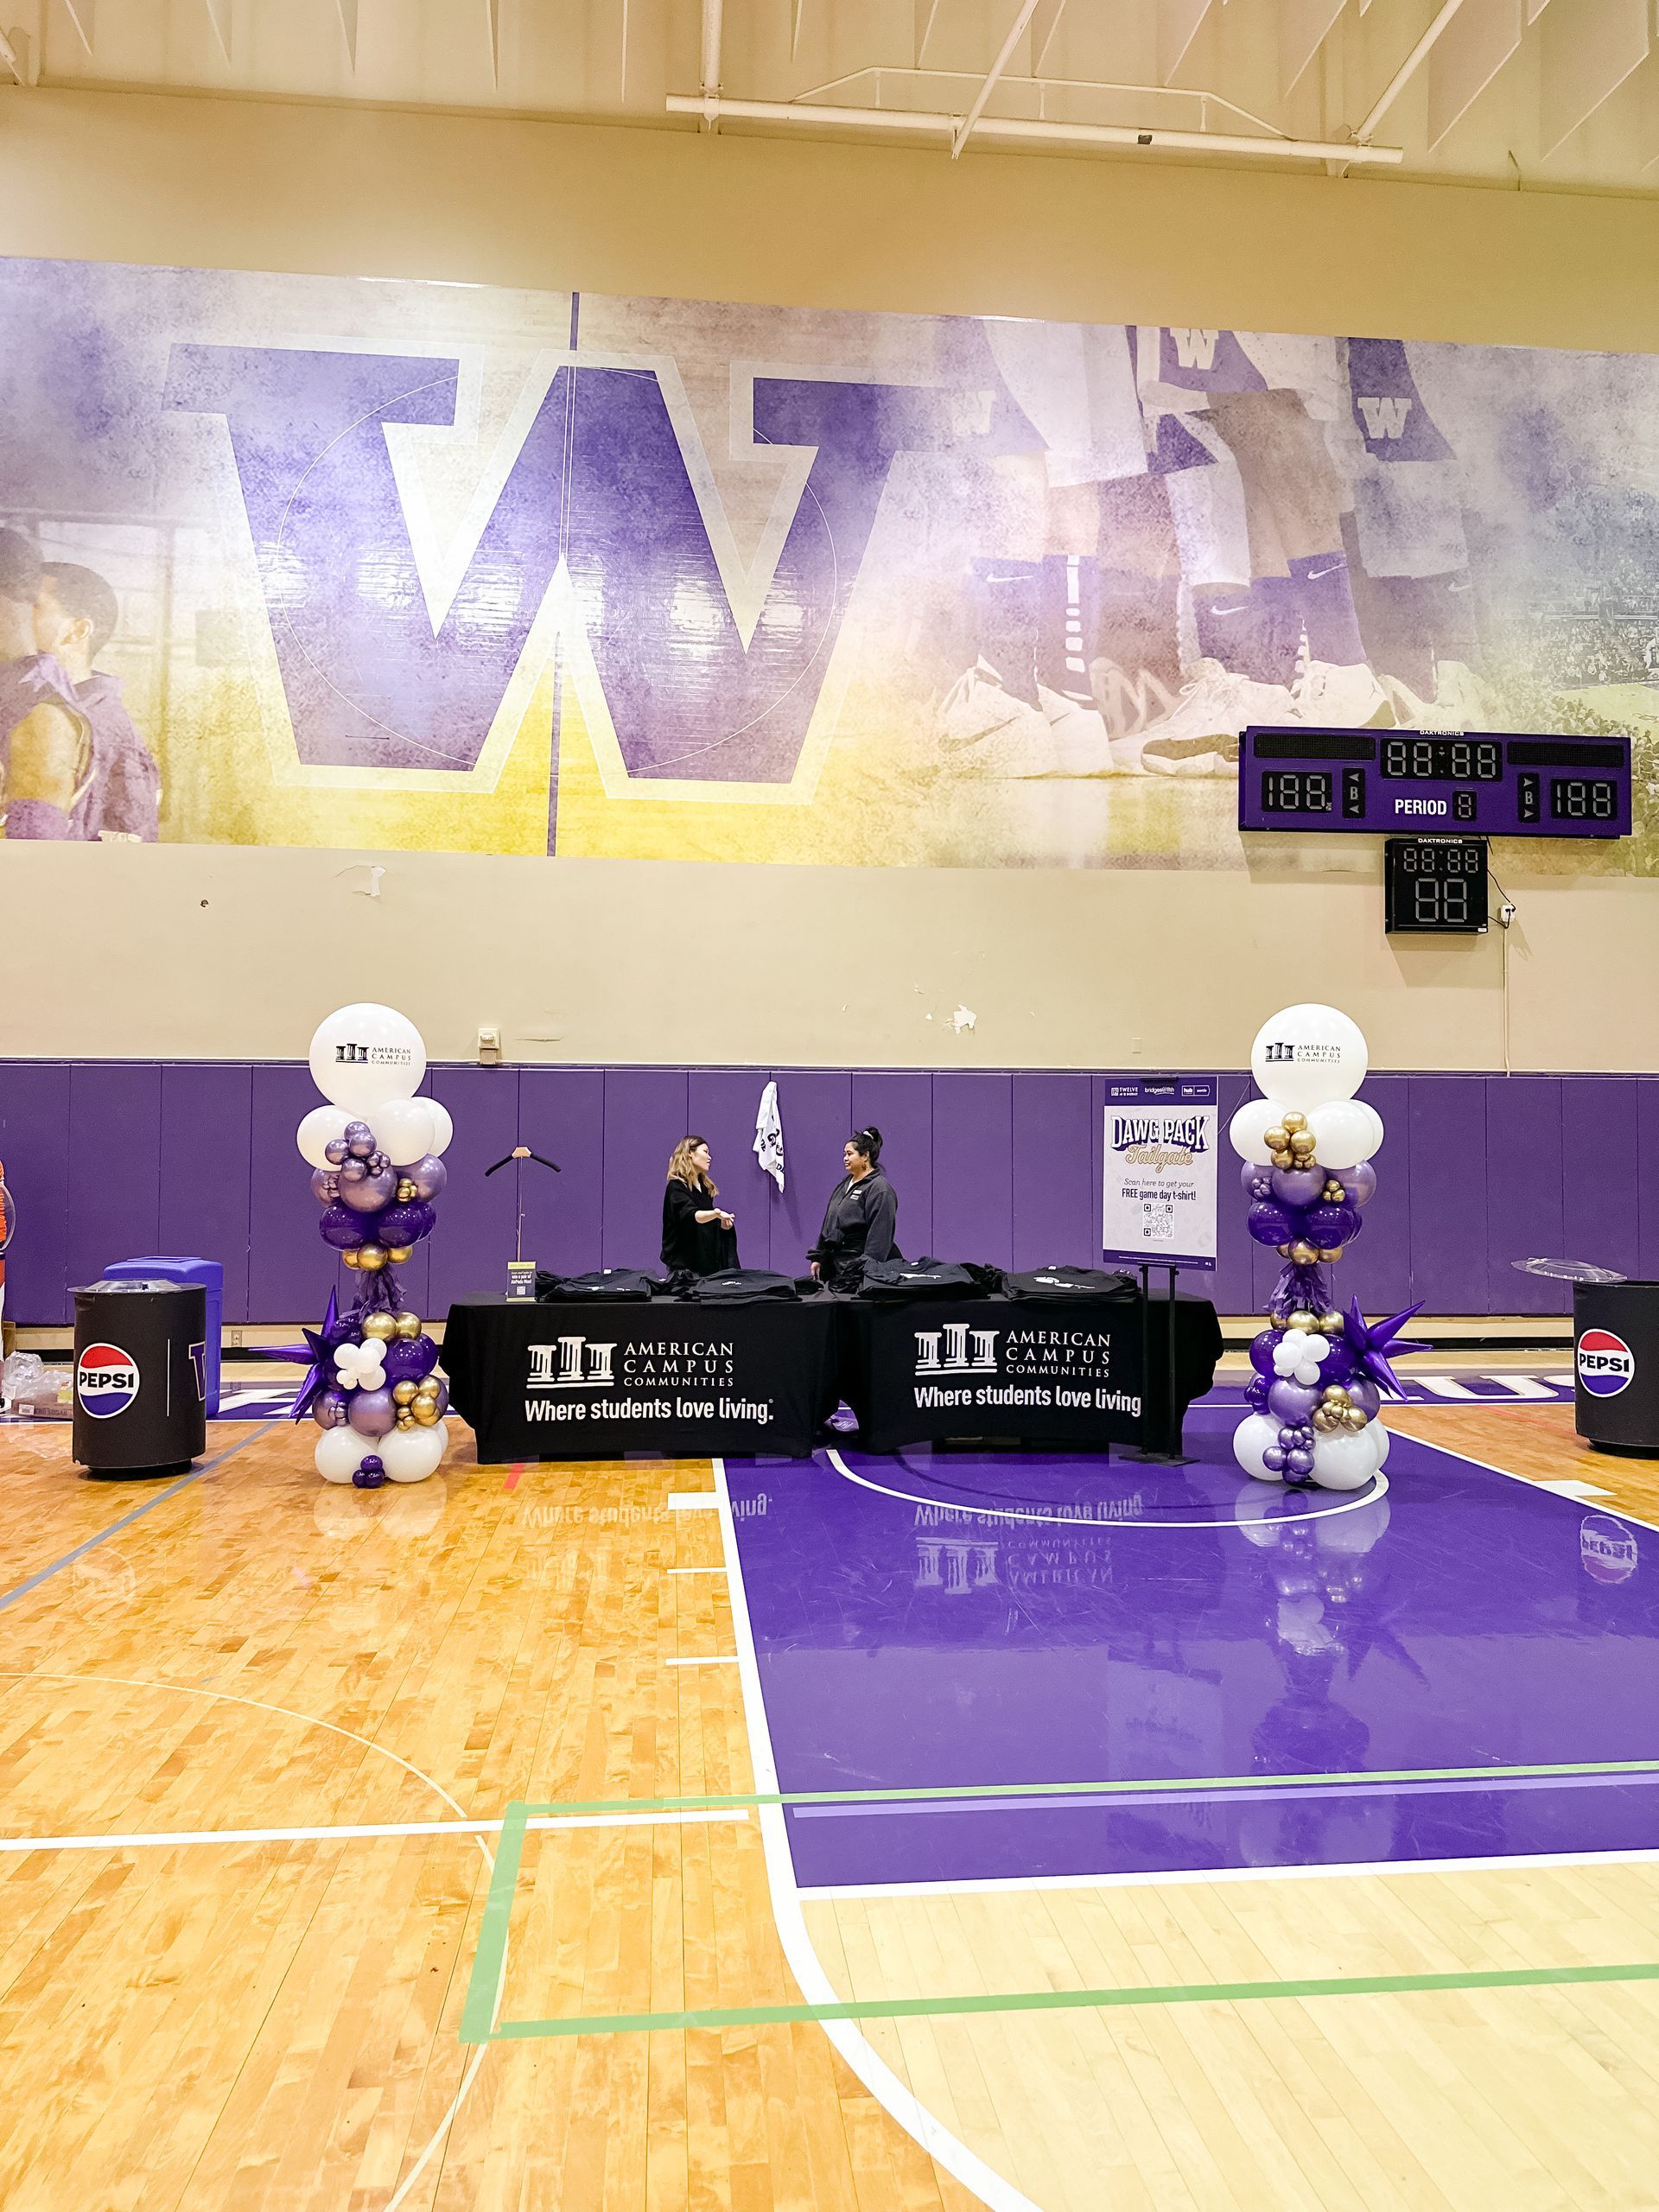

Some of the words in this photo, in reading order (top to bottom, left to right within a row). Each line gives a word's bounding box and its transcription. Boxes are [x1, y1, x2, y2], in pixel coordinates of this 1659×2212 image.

[1357, 396, 1413, 440] W
[1395, 798, 1447, 816] PERIOD
[1111, 1116, 1160, 1151] DAWG
[1163, 1116, 1211, 1152] PACK
[1125, 1144, 1193, 1173] Tailgate
[1166, 1179, 1177, 1188] get
[1122, 1188, 1138, 1198] FREE
[1140, 1191, 1158, 1200] game
[1159, 1191, 1172, 1201] day
[1173, 1190, 1196, 1200] t-shirt!
[1006, 1330, 1111, 1348] AMERICAN
[624, 1342, 734, 1357] AMERICAN
[1006, 1347, 1110, 1364] CAMPUS
[624, 1359, 734, 1374] CAMPUS
[1006, 1365, 1110, 1378] COMMUNITIES
[1579, 1353, 1630, 1373] PEPSI
[79, 1371, 134, 1389] PEPSI
[624, 1376, 734, 1387] COMMUNITIES
[524, 1400, 586, 1422] Where
[590, 1397, 671, 1419] students
[677, 1396, 713, 1419] love
[914, 1385, 972, 1408] Where
[976, 1384, 1052, 1406] students
[1056, 1385, 1090, 1408] love
[1095, 1389, 1141, 1418] living
